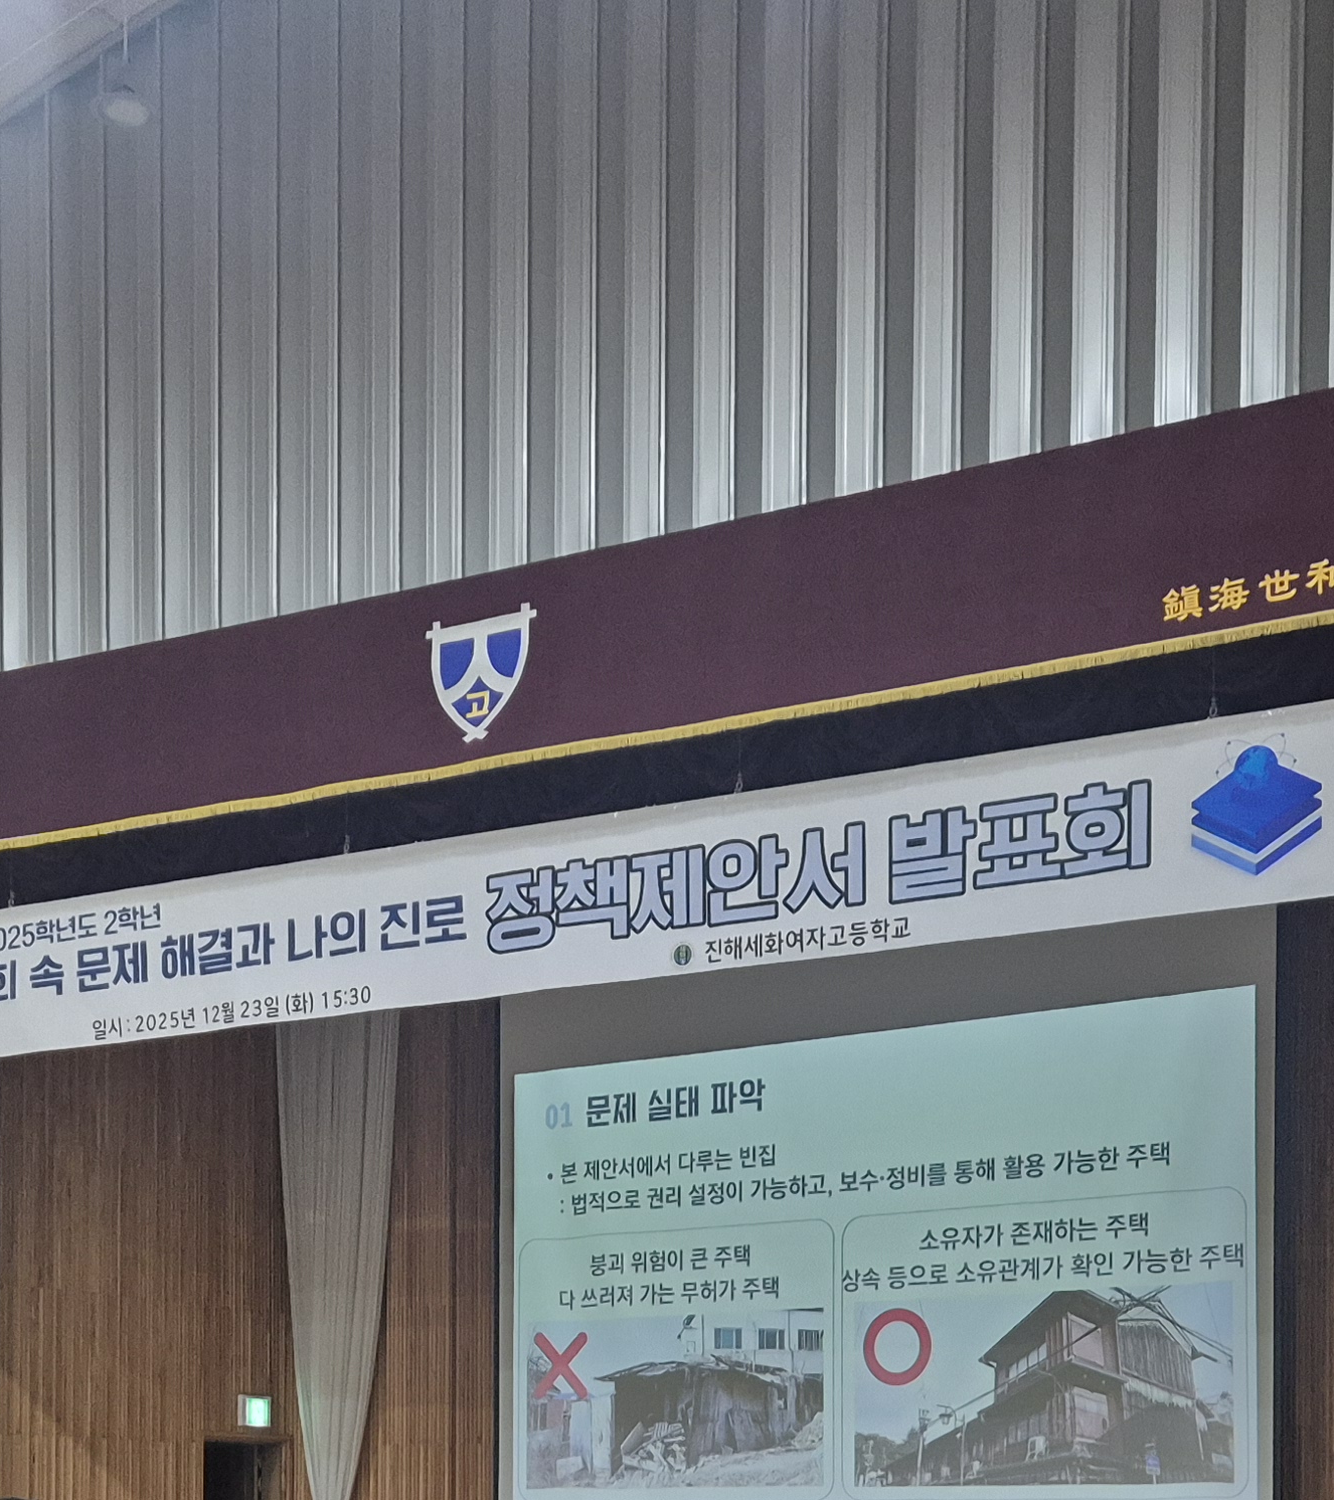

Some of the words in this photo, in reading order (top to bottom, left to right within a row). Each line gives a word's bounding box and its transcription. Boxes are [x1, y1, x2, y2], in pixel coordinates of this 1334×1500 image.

[485, 819, 867, 955] 정책제안서
[888, 778, 1152, 906] 발표회
[104, 903, 161, 936] 2학년
[705, 916, 912, 964] 진해세화여자고등학교
[29, 954, 65, 996] 속
[77, 940, 149, 993] 문제
[160, 922, 276, 980] 해결과
[287, 908, 366, 962] 나의
[380, 895, 468, 952] 진로
[202, 1000, 236, 1026] 12월
[240, 995, 280, 1020] 23일
[285, 991, 315, 1016] (화)
[321, 985, 372, 1011] 15:30
[545, 1102, 573, 1131] 01
[586, 1091, 637, 1129] 문제
[648, 1084, 700, 1122] 실태
[710, 1077, 767, 1115] 파악
[560, 1161, 578, 1185] 본
[583, 1154, 672, 1182] 제안서에서
[678, 1148, 734, 1175] 다루는
[739, 1143, 777, 1170] 빈집
[571, 1189, 642, 1217] 법적으로
[646, 1184, 683, 1210] 권리
[688, 1179, 744, 1207] 설정이
[750, 1173, 834, 1202] 가능하고,
[953, 1157, 996, 1185] 통해
[1002, 1153, 1046, 1180] 활용
[1053, 1146, 1120, 1175] 가능한
[1126, 1141, 1171, 1170] 주택
[919, 1223, 1004, 1252] 소유자가
[1010, 1217, 1099, 1247] 존재하는
[1105, 1211, 1150, 1240] 주택
[590, 1252, 626, 1277] 붕괴
[630, 1248, 685, 1274] 위험이
[689, 1247, 709, 1271] 큰
[713, 1243, 752, 1269] 주택
[841, 1266, 881, 1293] 상속
[887, 1263, 950, 1290] 등으로
[955, 1254, 1064, 1285] 소유관계가
[1070, 1250, 1114, 1279] 확인
[1122, 1246, 1193, 1275] 가능한
[1198, 1242, 1245, 1270] 주택
[558, 1289, 576, 1311] 다
[580, 1285, 633, 1308] 쓰러져
[639, 1282, 675, 1306] 가는
[680, 1278, 738, 1304] 무허가
[741, 1275, 781, 1300] 주택
